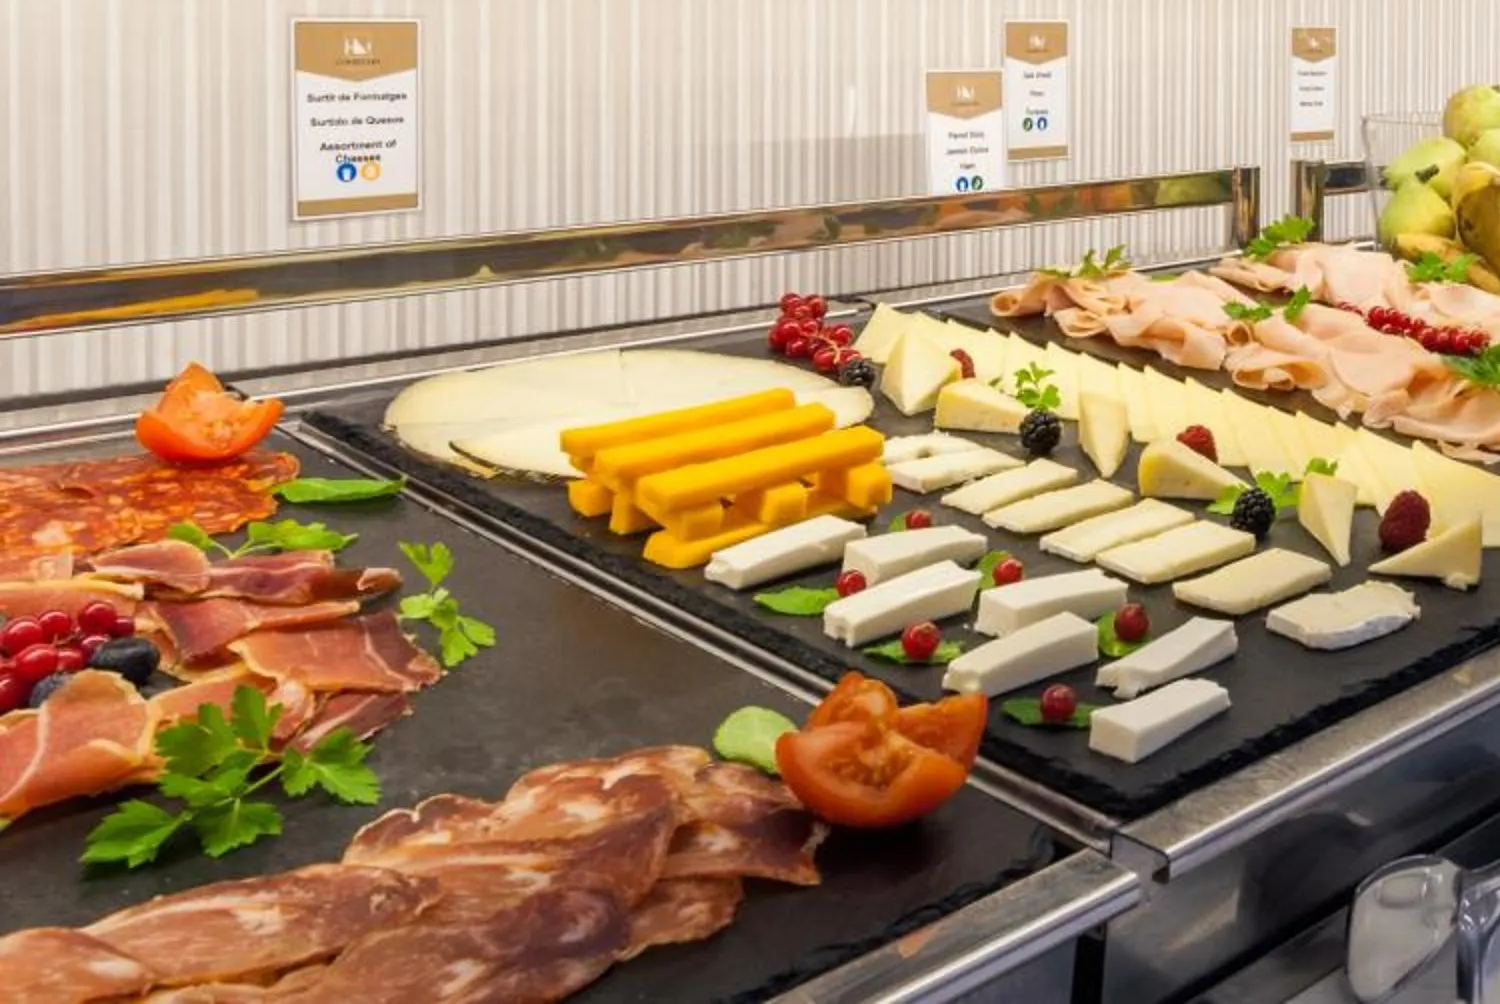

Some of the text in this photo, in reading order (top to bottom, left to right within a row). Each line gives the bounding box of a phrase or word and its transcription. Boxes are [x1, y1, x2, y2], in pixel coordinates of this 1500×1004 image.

[338, 93, 351, 101] de
[310, 117, 348, 127] Surtido
[351, 116, 363, 125] de
[319, 139, 398, 151] Assortment of
